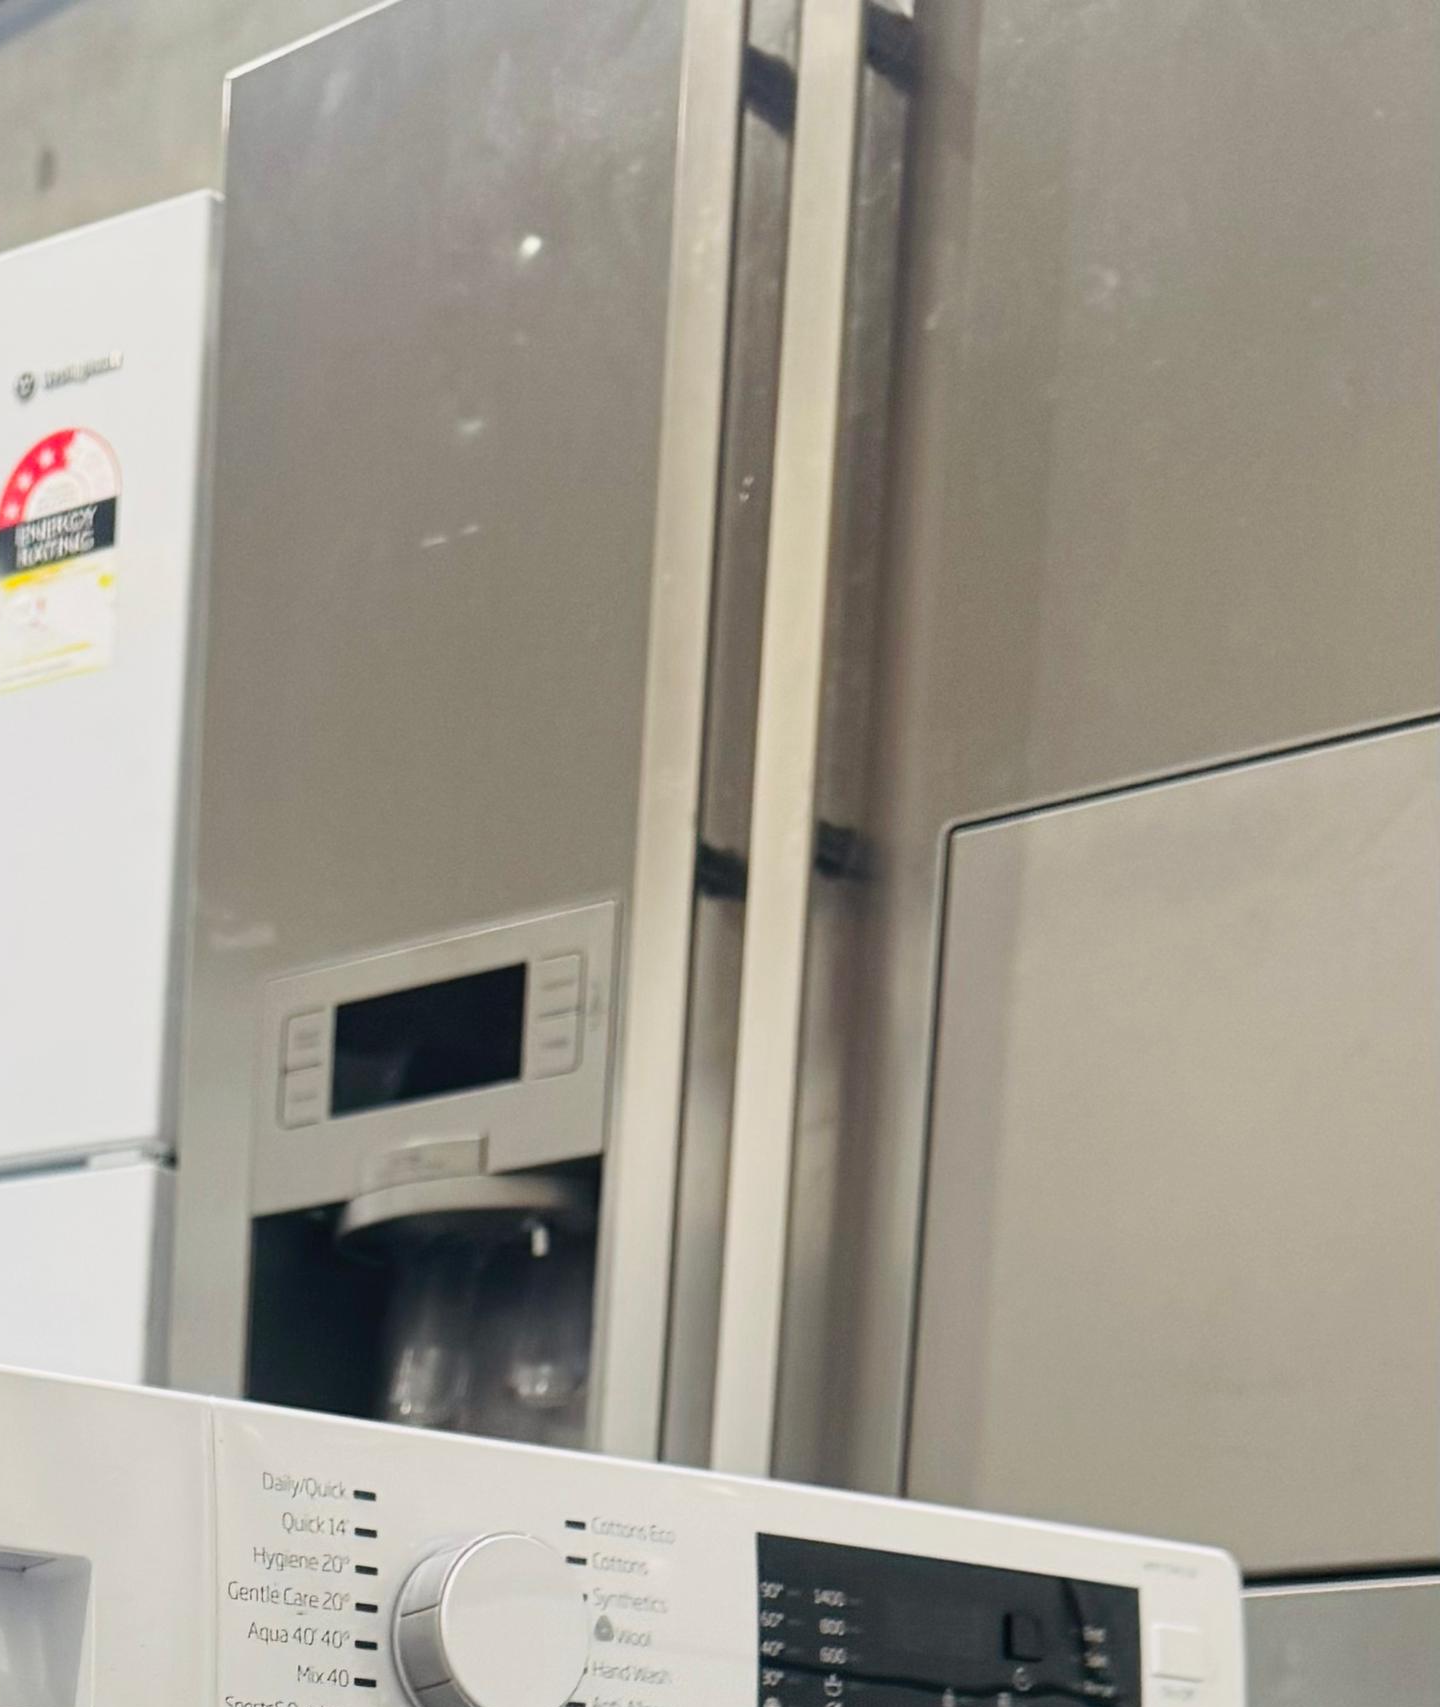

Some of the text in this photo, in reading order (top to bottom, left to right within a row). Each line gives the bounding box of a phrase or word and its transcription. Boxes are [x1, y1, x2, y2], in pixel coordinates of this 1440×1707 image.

[262, 1472, 346, 1499] Daily/Quick
[282, 1512, 324, 1534] Quick
[253, 1547, 318, 1571] Hygiene
[228, 1581, 279, 1603] Gentle
[283, 1587, 318, 1608] Care
[248, 1622, 288, 1645] Aqua
[297, 1664, 349, 1687] Mix 40
